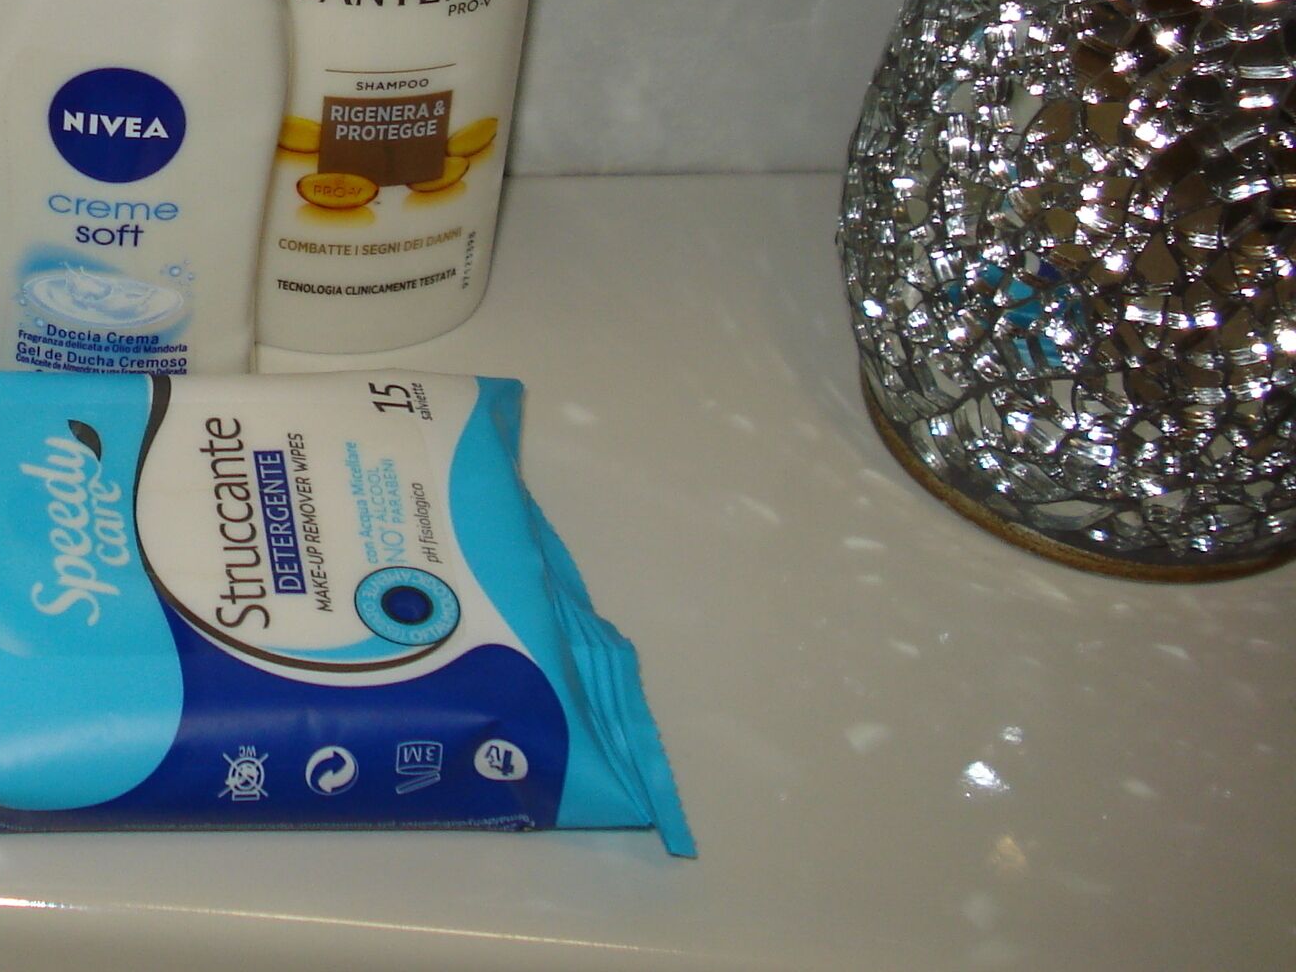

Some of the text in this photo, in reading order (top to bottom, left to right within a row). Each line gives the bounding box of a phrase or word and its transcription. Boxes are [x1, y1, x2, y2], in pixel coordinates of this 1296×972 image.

[356, 78, 429, 91] SHAMPOO
[63, 109, 169, 139] NIVEA
[331, 100, 445, 122] RIGENERA &
[335, 120, 437, 141] PROTEGGE
[48, 194, 179, 221] creme
[75, 224, 144, 247] soft
[278, 238, 352, 256] COMBATTE
[361, 241, 400, 256] SEGNI
[404, 238, 424, 253] DEI
[277, 268, 457, 296] TECNOLOGIA CLINICAMENTE TESTATA
[18, 329, 64, 347] Fragranza
[65, 340, 104, 352] delicata
[47, 323, 160, 345] Doccia Crema
[17, 341, 187, 368] Gel de Ducha Cremoso
[368, 381, 415, 413] 15
[411, 382, 433, 421] salviette
[344, 441, 379, 565] con Acqua Micellare
[366, 466, 388, 524] ALCOOL
[379, 458, 406, 524] PARABENI
[19, 436, 119, 627] Speedy
[88, 478, 130, 567] care
[199, 417, 270, 629] Struccante
[258, 452, 303, 592] DETERGENTE
[287, 432, 334, 613] MAKE-UP REMOVER WIPES
[411, 482, 442, 565] pH fisiologico
[403, 745, 434, 763] 3M
